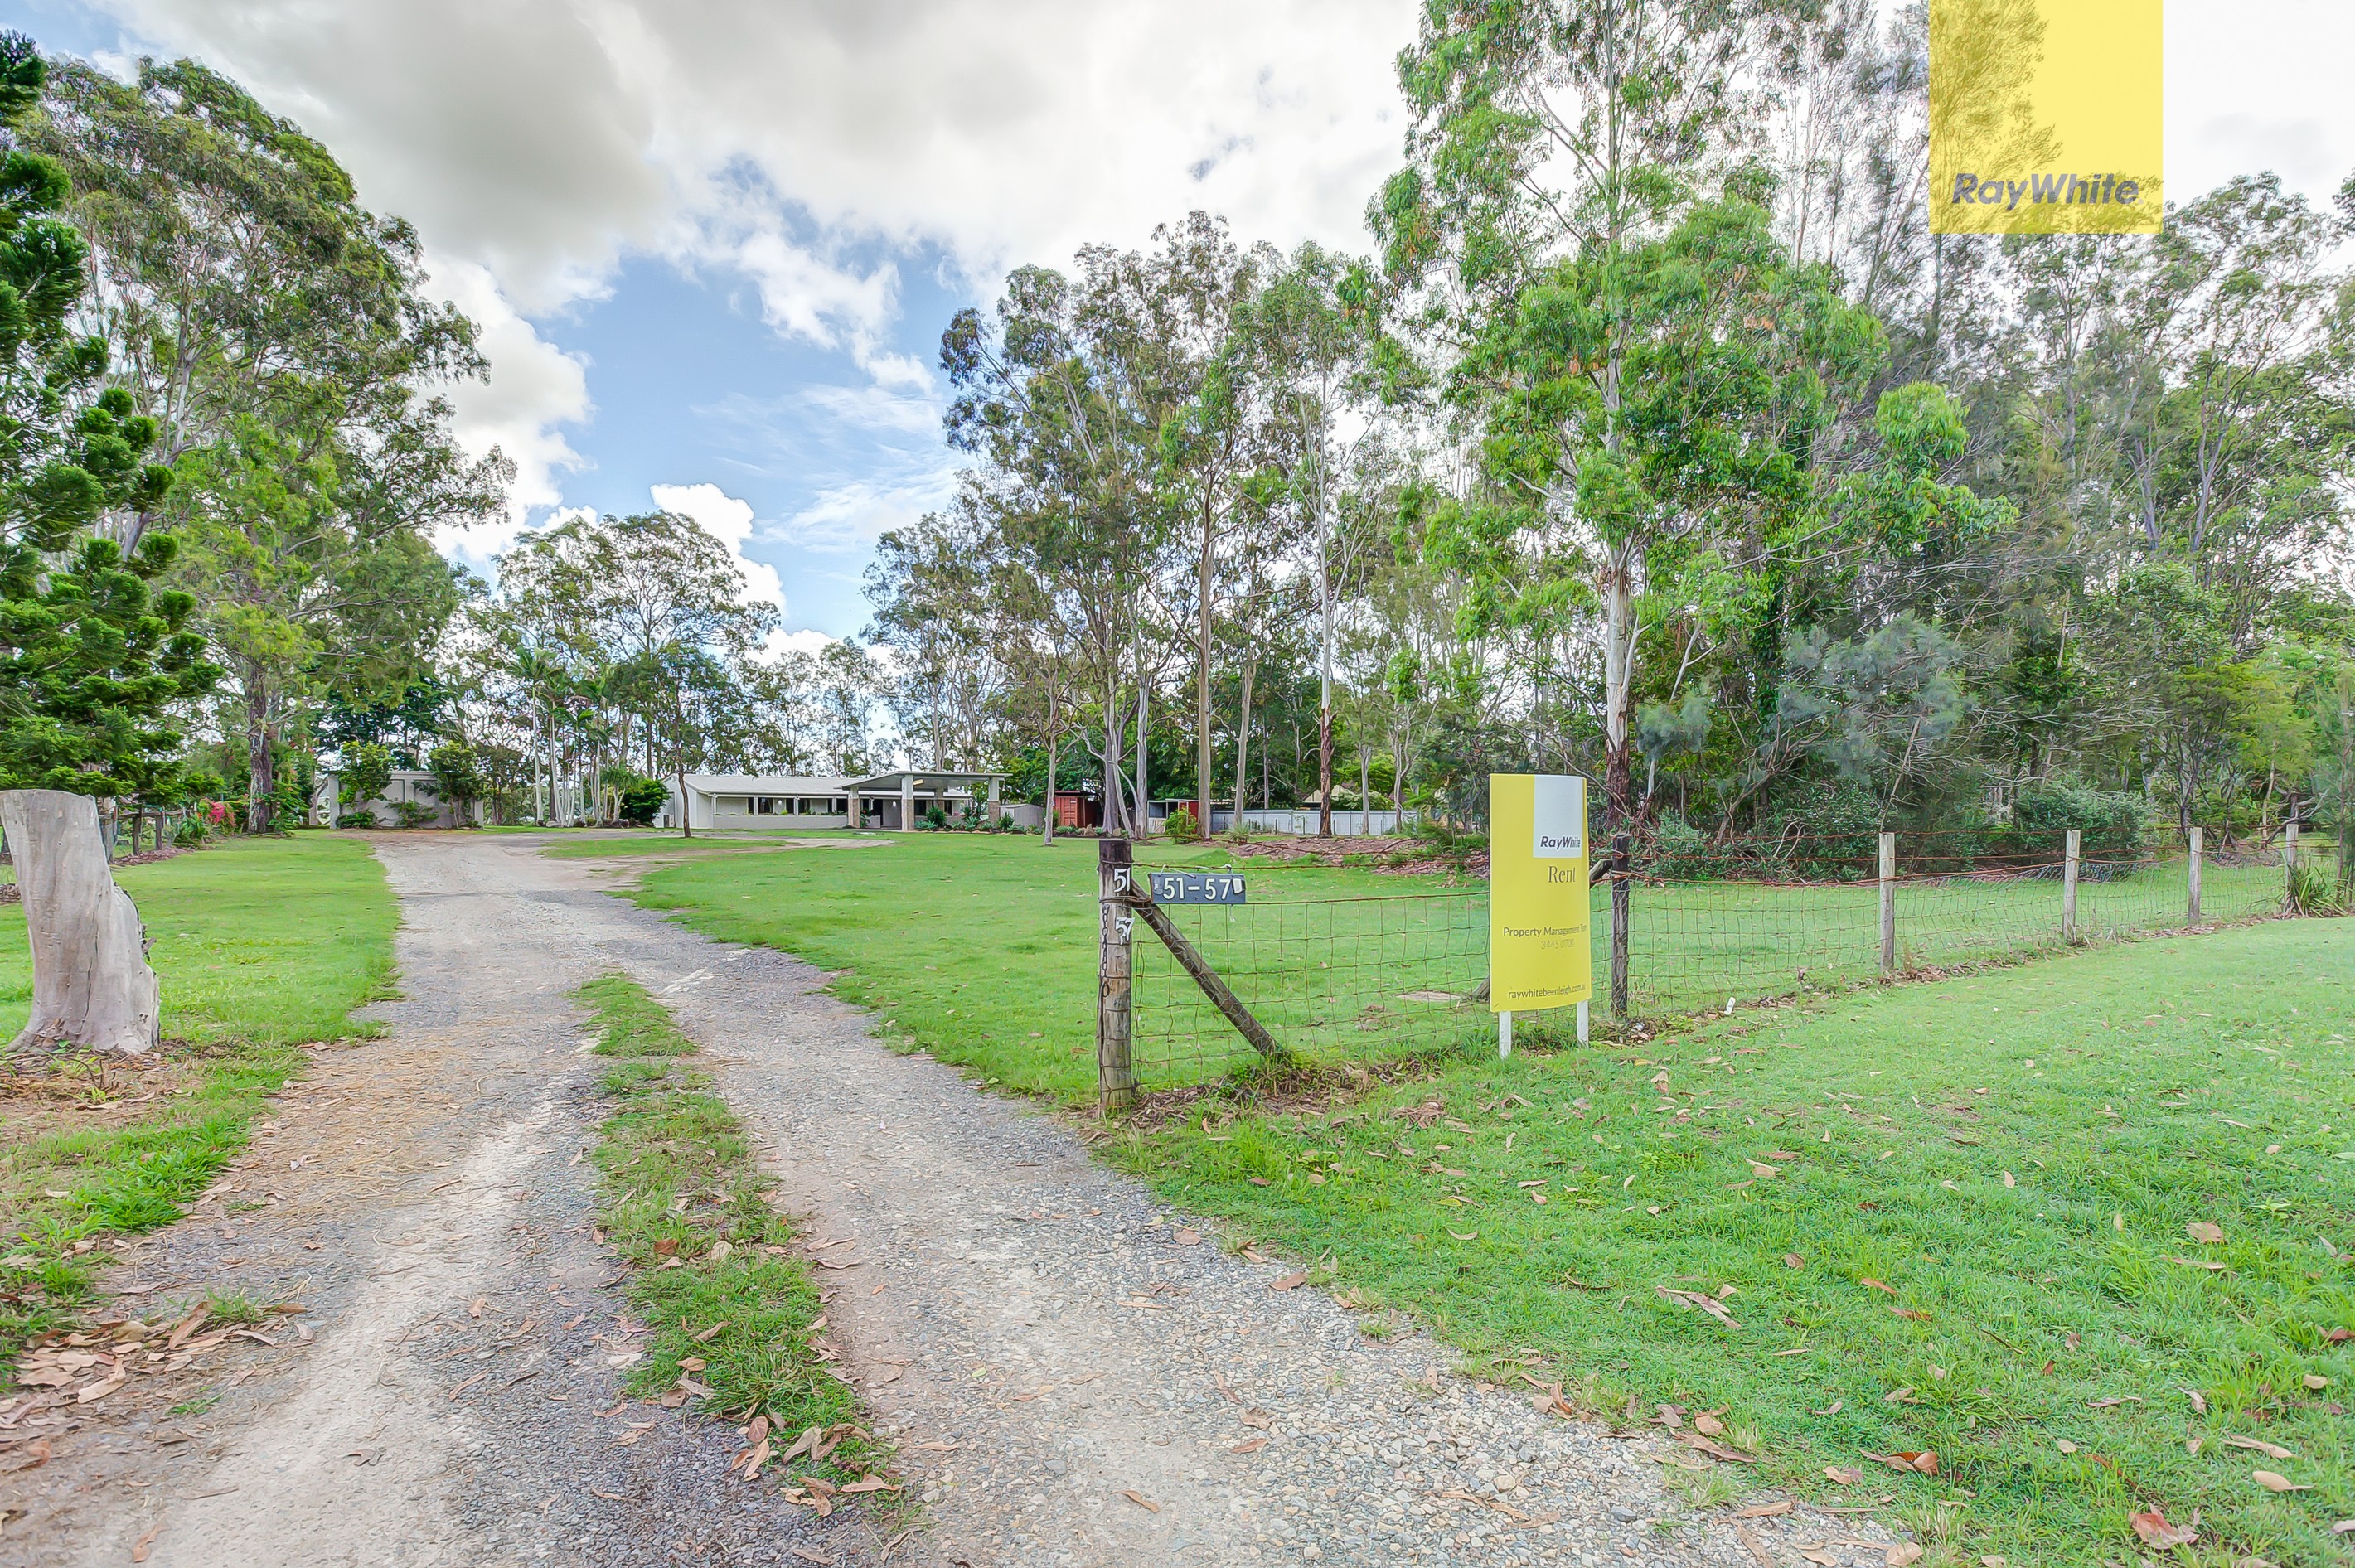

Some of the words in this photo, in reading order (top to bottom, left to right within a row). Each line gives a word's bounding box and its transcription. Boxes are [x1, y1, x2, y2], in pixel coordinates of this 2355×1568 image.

[1114, 868, 1131, 893] 51
[1548, 865, 1576, 883] Rent
[1503, 927, 1542, 937] Property
